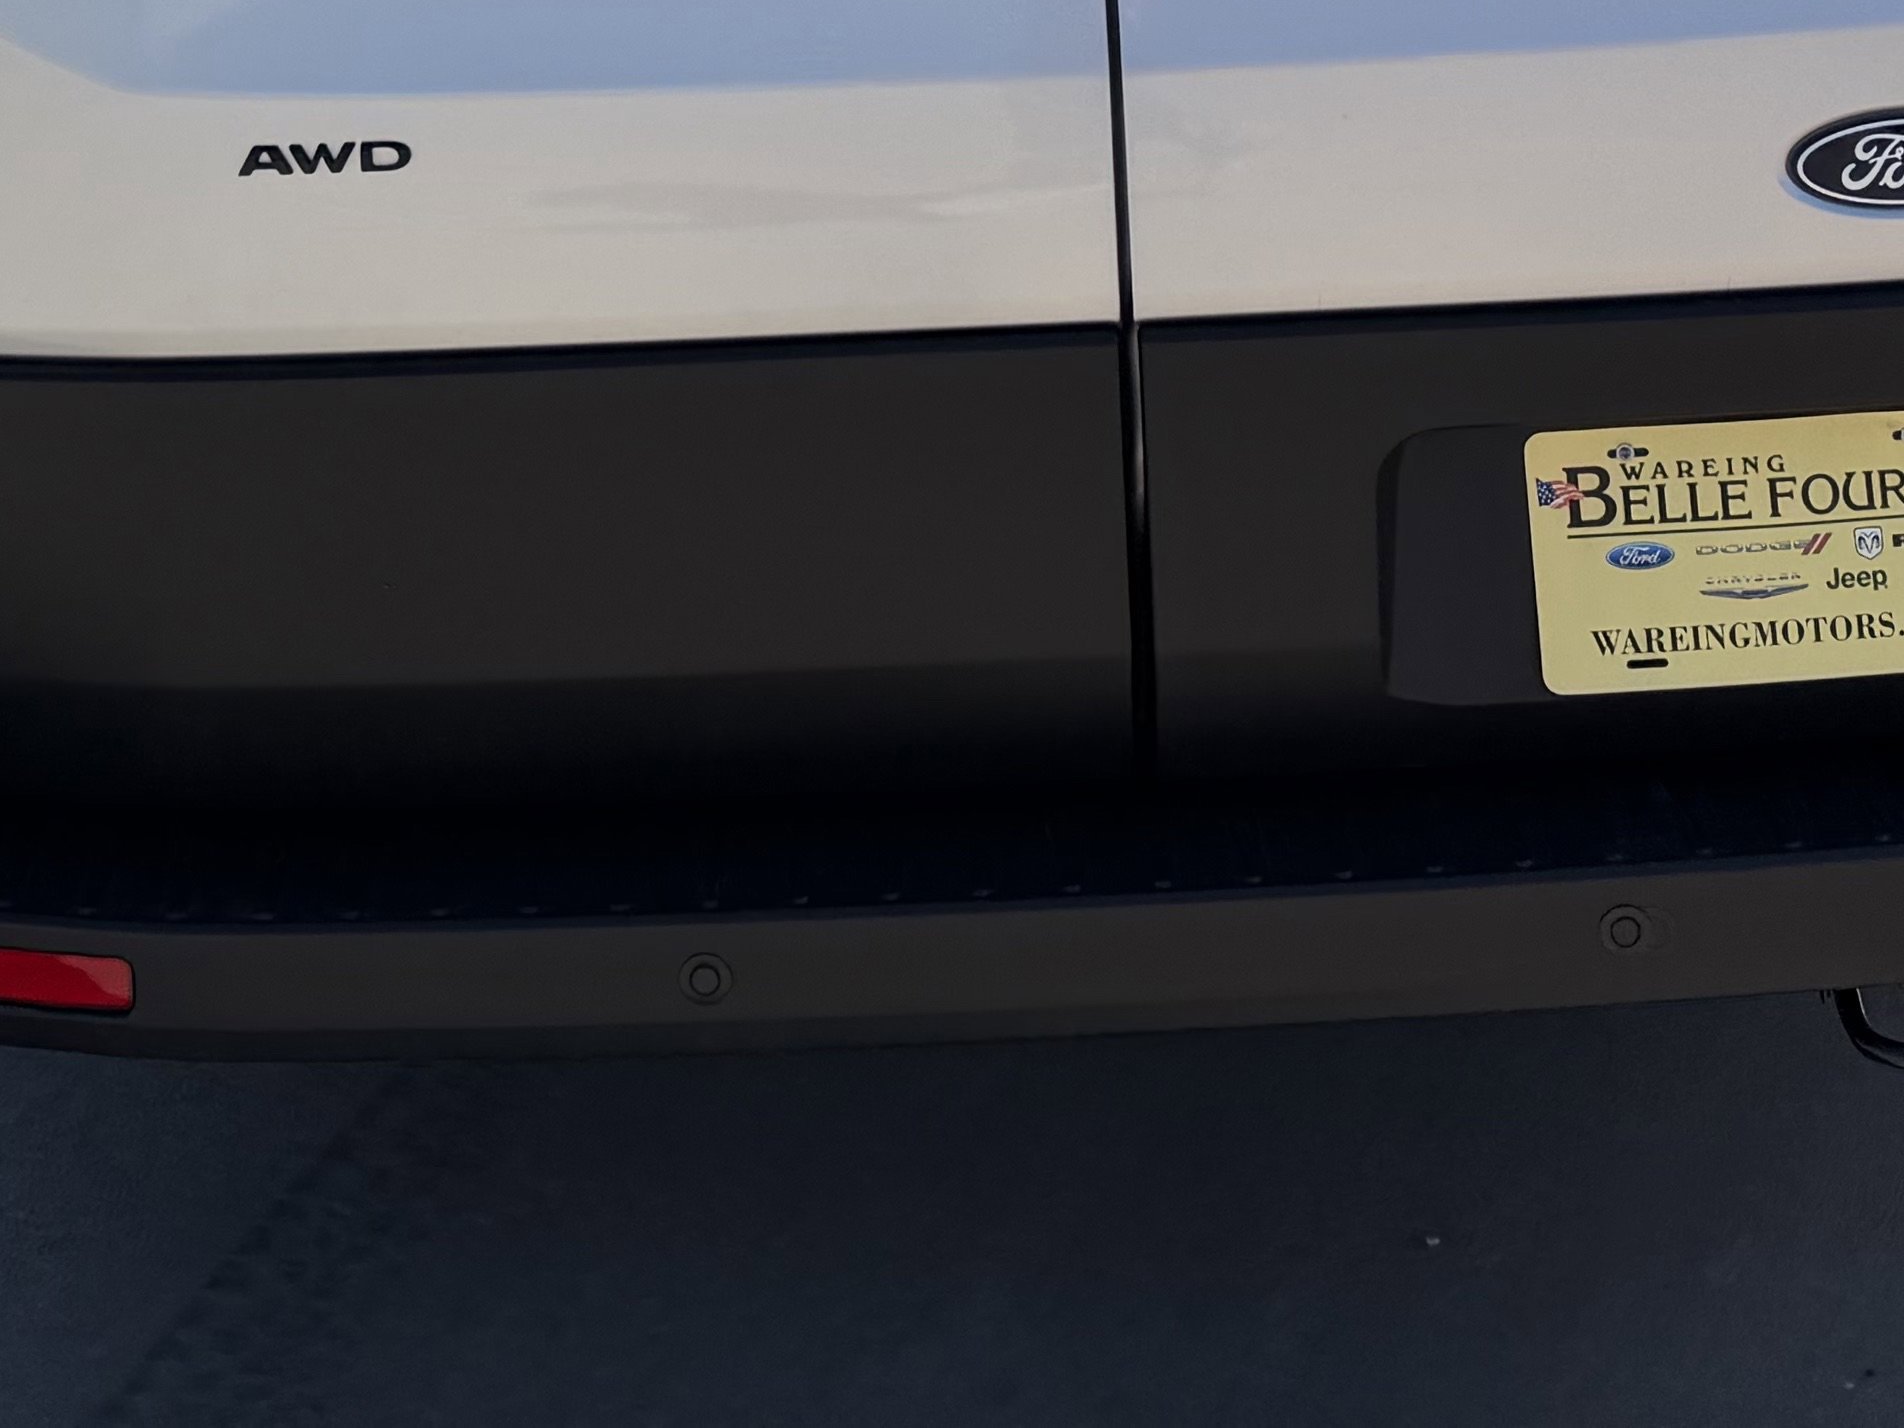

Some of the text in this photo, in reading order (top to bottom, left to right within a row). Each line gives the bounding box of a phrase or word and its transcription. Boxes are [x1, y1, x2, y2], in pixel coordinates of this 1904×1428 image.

[238, 141, 412, 177] AWD
[1619, 454, 1786, 481] WAREING
[1561, 466, 1752, 529] BELLE
[1696, 538, 1814, 556] DODGE
[1826, 567, 1889, 591] Jeep
